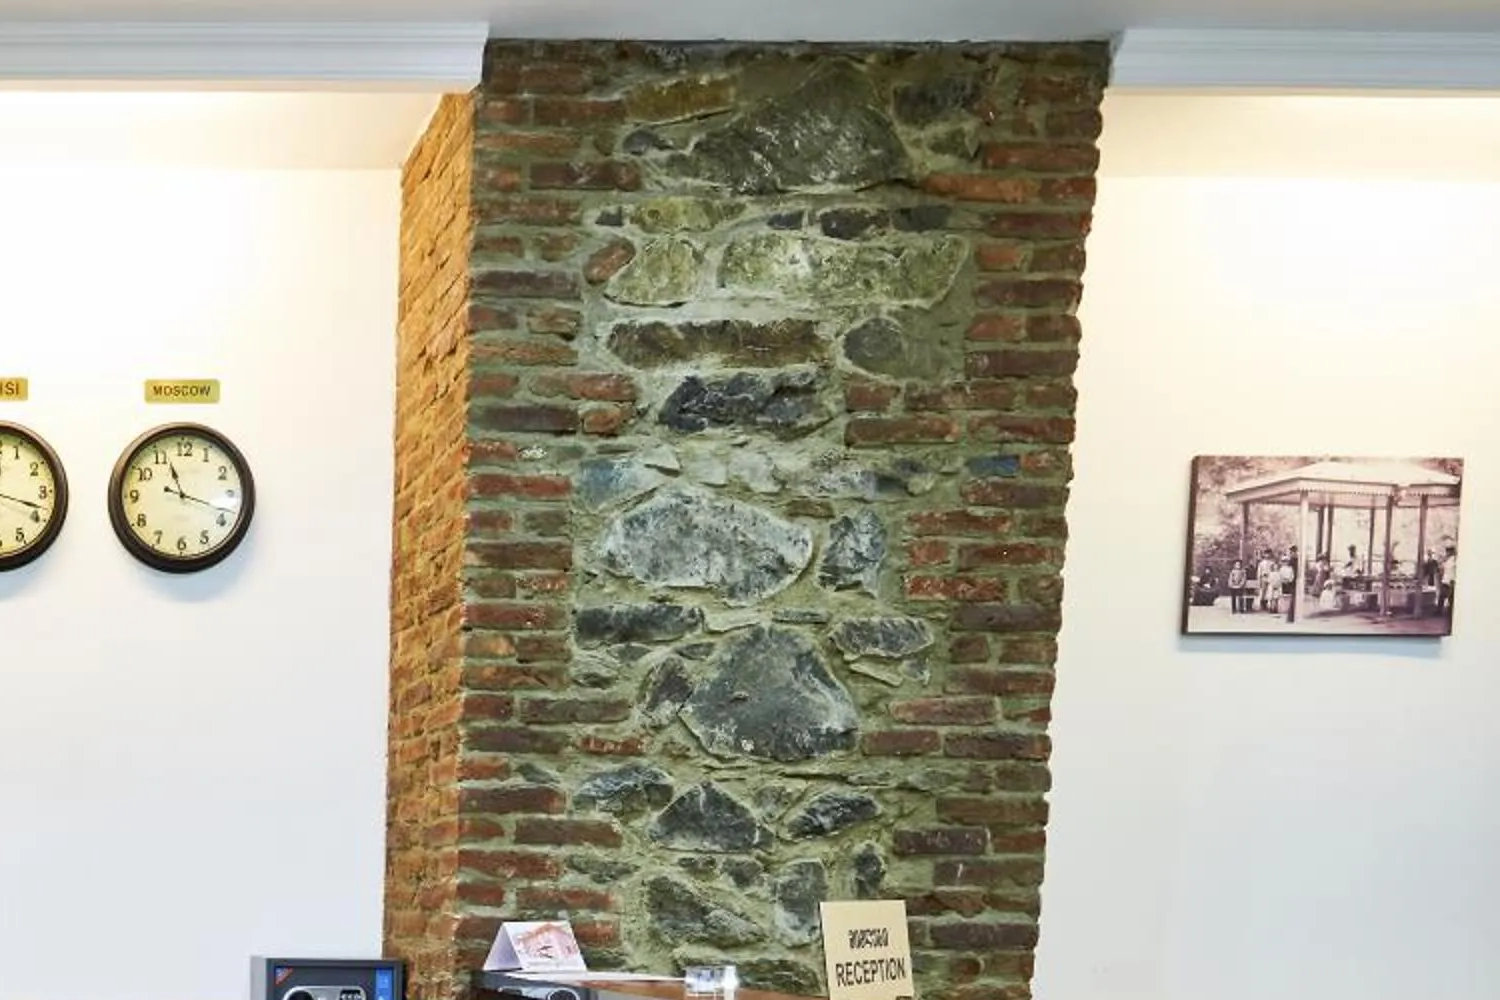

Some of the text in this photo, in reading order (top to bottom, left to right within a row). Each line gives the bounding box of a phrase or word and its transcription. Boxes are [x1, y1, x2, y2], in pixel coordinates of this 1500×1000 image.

[153, 385, 211, 397] MOSCOW
[13, 446, 20, 460] 1
[176, 442, 193, 457] 12
[202, 448, 209, 462] 1
[154, 451, 167, 464] 11
[30, 462, 39, 476] 2
[137, 467, 152, 481] 10
[218, 466, 227, 480] 2
[38, 485, 47, 499] 3
[129, 490, 139, 503] 9
[30, 510, 40, 523] 4
[137, 514, 147, 528] 8
[216, 513, 226, 527] 4
[15, 528, 24, 542] 5
[154, 531, 163, 544] 7
[200, 530, 209, 544] 5
[177, 536, 187, 550] 6
[835, 957, 906, 987] RECEPTION
